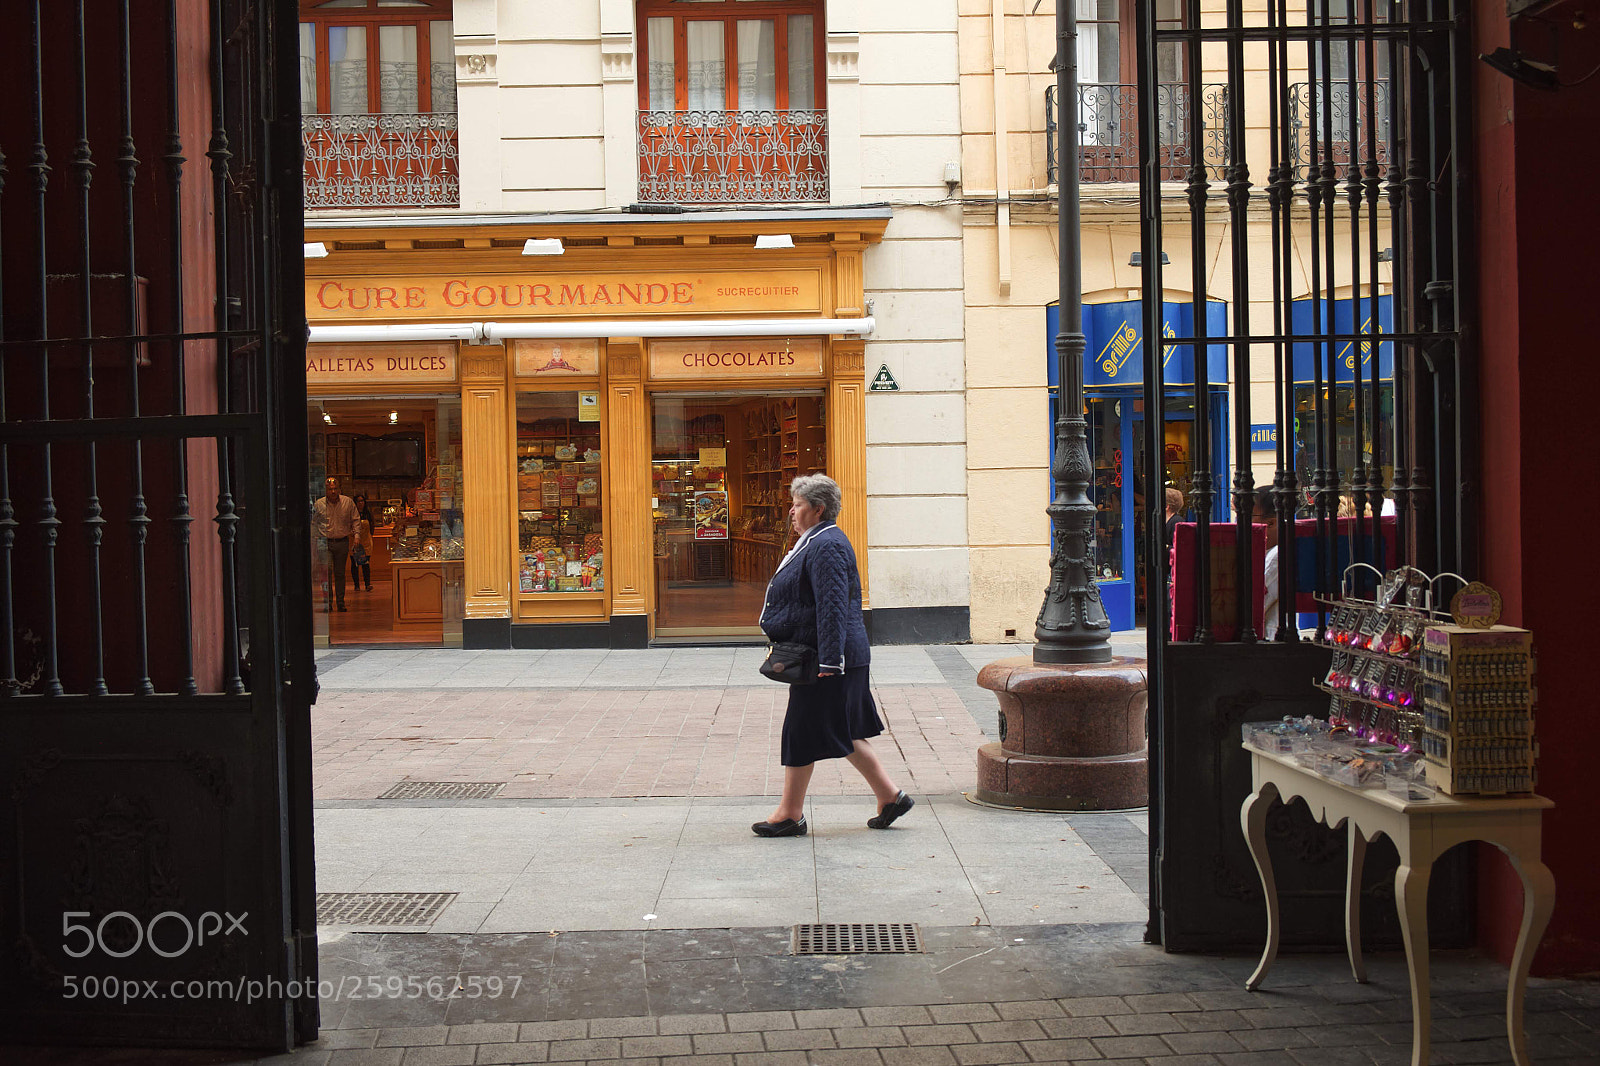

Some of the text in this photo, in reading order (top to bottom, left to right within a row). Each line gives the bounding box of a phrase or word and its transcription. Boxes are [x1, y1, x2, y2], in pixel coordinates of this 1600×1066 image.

[317, 278, 694, 312] CURE GOURMANDE
[717, 286, 799, 297] SUCRECUITIER
[306, 356, 446, 372] ALLETAS DULCES
[682, 351, 795, 367] CHOCOLATES
